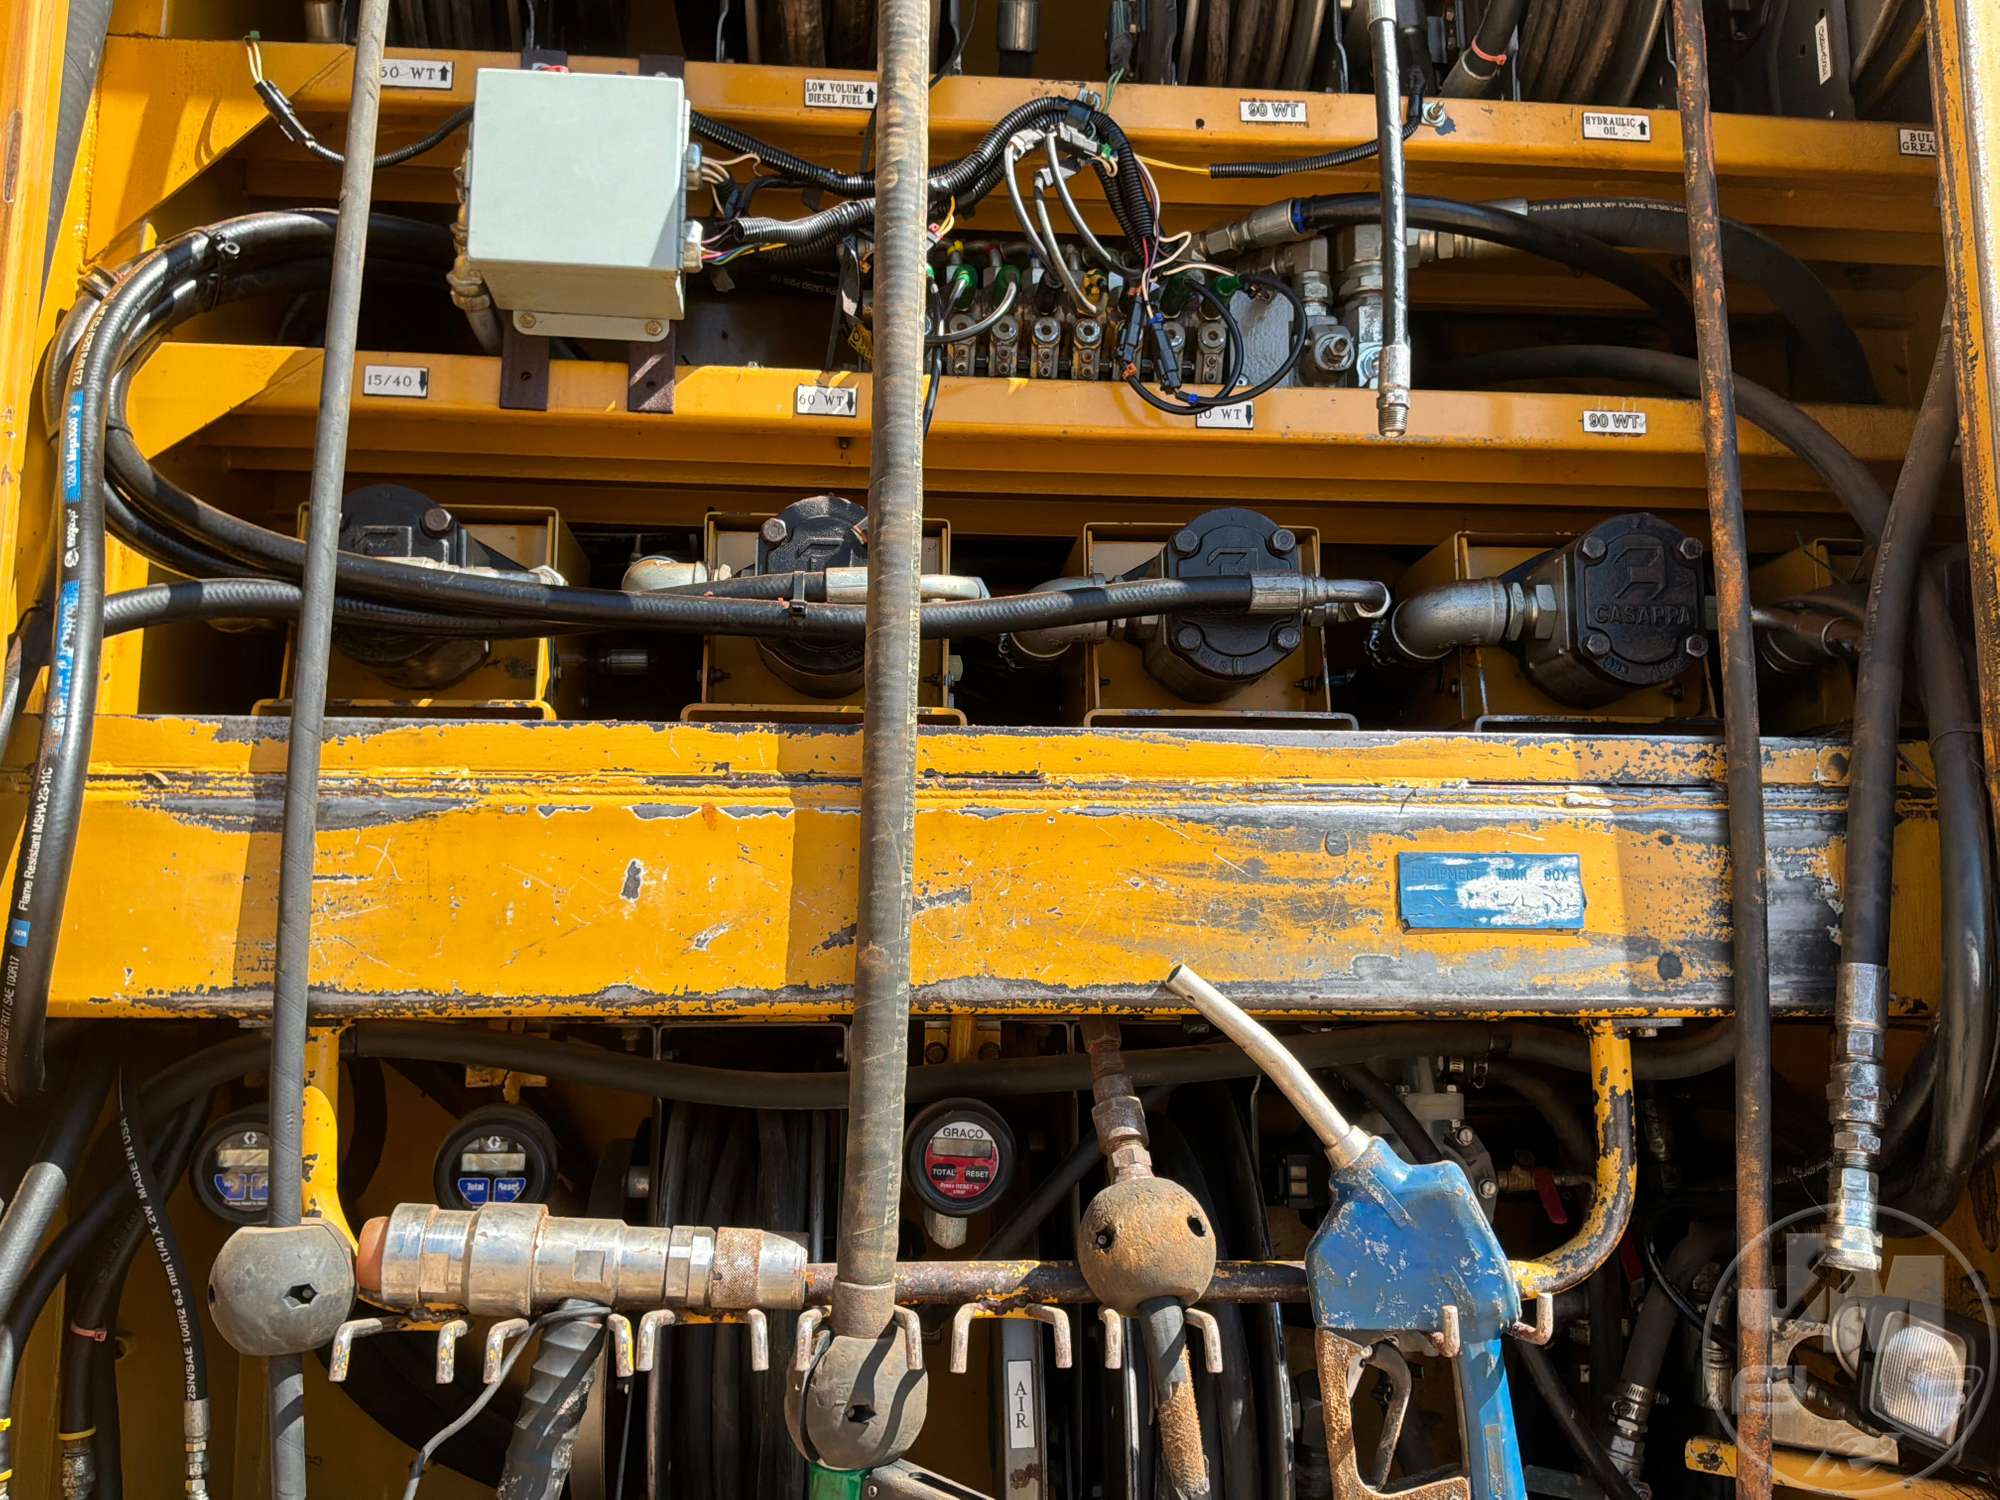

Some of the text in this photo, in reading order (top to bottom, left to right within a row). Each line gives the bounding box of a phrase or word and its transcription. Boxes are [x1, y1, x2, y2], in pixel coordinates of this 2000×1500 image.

[410, 66, 436, 80] WT
[806, 82, 865, 94] LOW VOLUME
[808, 93, 863, 104] DIESEL FUEL
[1248, 103, 1298, 118] 90 WT
[1585, 115, 1636, 128] HYDRAULIC
[1603, 126, 1618, 136] OIL
[1909, 132, 1934, 143] BUL
[1902, 141, 1936, 153] GREA
[367, 374, 412, 387] 15/40
[798, 394, 844, 406] 60 WT
[1220, 408, 1242, 420] WT
[1588, 413, 1640, 429] 90 WT
[1594, 603, 1693, 626] CASAPPA
[37, 766, 53, 802] 2G-11C
[32, 802, 48, 833] MSHA
[24, 834, 42, 879] Resistant
[1499, 867, 1528, 881] TANK
[1543, 868, 1569, 882] BOX
[17, 880, 34, 912] Flame
[120, 1117, 132, 1145] USA
[943, 1127, 984, 1139] GRACO
[125, 1146, 136, 1160] IN
[129, 1160, 148, 1200] MADE
[932, 1168, 989, 1178] TOTAL RESET
[467, 1182, 520, 1191] Total Reset
[143, 1205, 157, 1224] 2W
[154, 1237, 172, 1263] (1/4)
[165, 1264, 179, 1286] mm
[183, 1345, 197, 1401] 2SN/SAE
[1014, 1380, 1029, 1429] AIR
